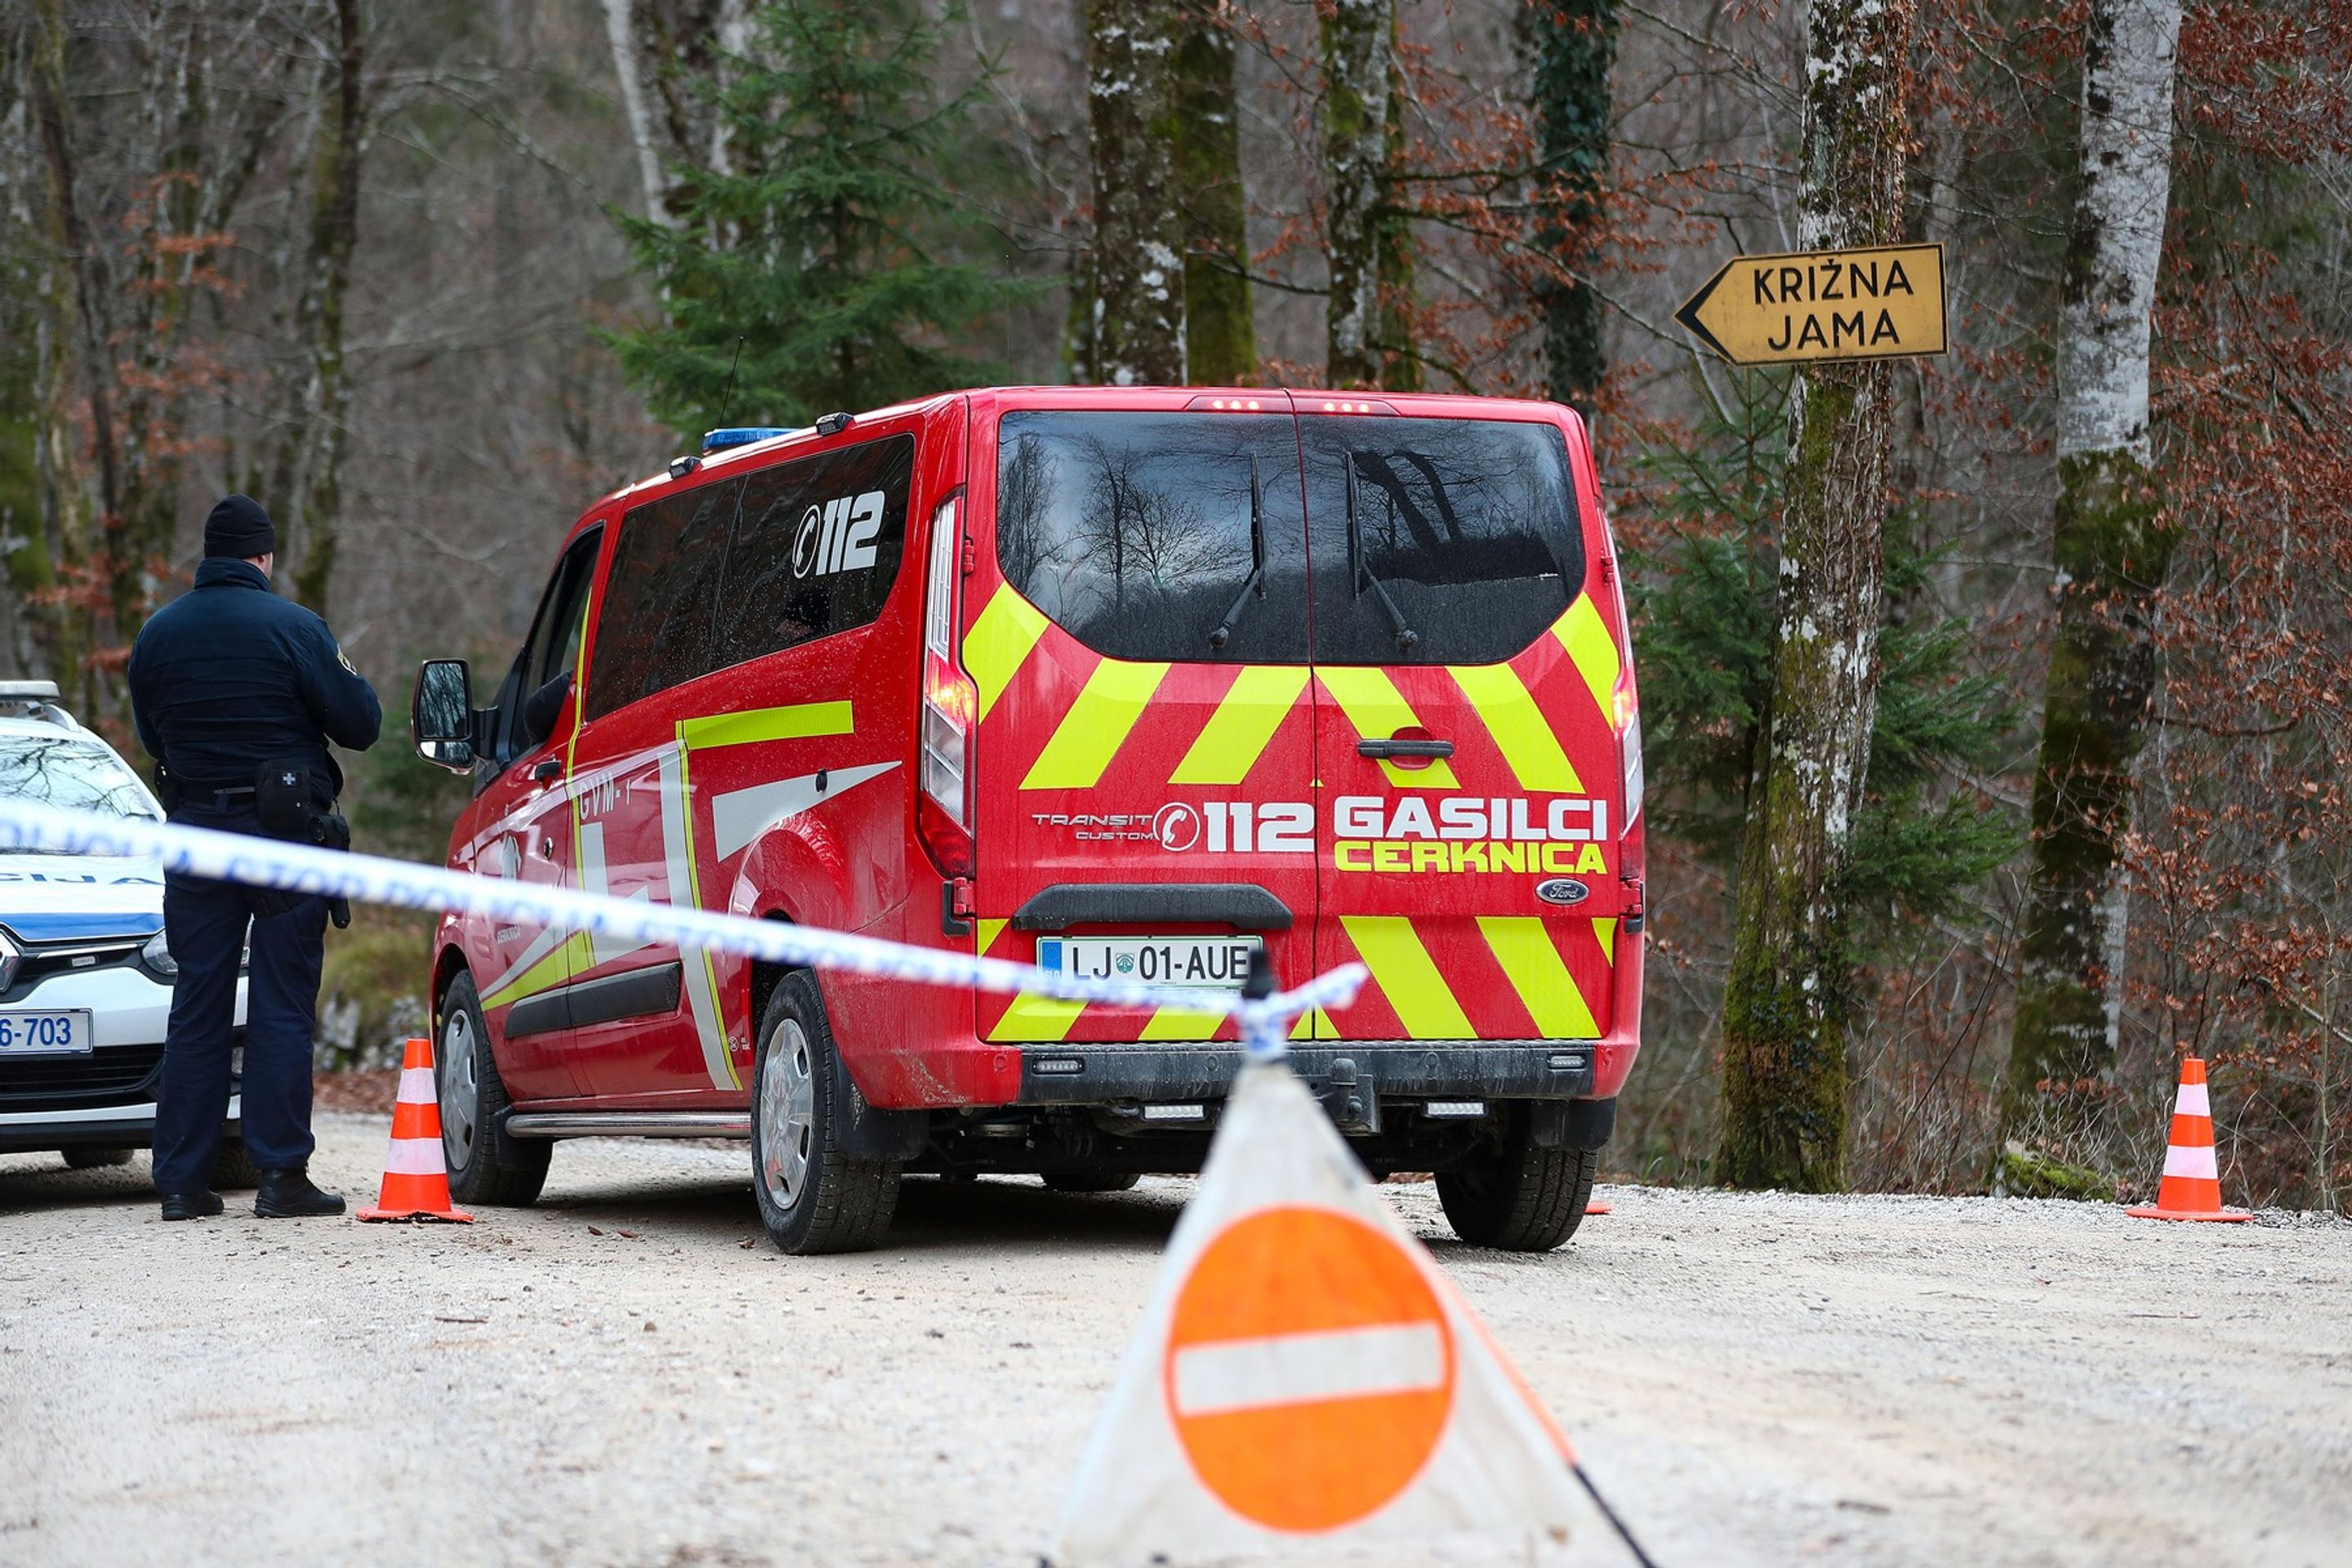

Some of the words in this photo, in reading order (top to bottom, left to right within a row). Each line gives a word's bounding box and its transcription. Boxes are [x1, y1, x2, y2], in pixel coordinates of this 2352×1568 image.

[1753, 258, 1914, 305] KRIŽNA
[1767, 309, 1900, 351] JAMA
[816, 490, 885, 576] 112
[1032, 814, 1153, 826] TRANSIT
[1076, 831, 1155, 840] CUSTOM
[1203, 802, 1315, 852] 112
[1334, 796, 1607, 840] GASILCI
[1334, 840, 1608, 875] CERKNICA
[1073, 947, 1111, 980] LJ
[1139, 946, 1249, 980] 01-AUE
[0, 1017, 71, 1047] 6-703
